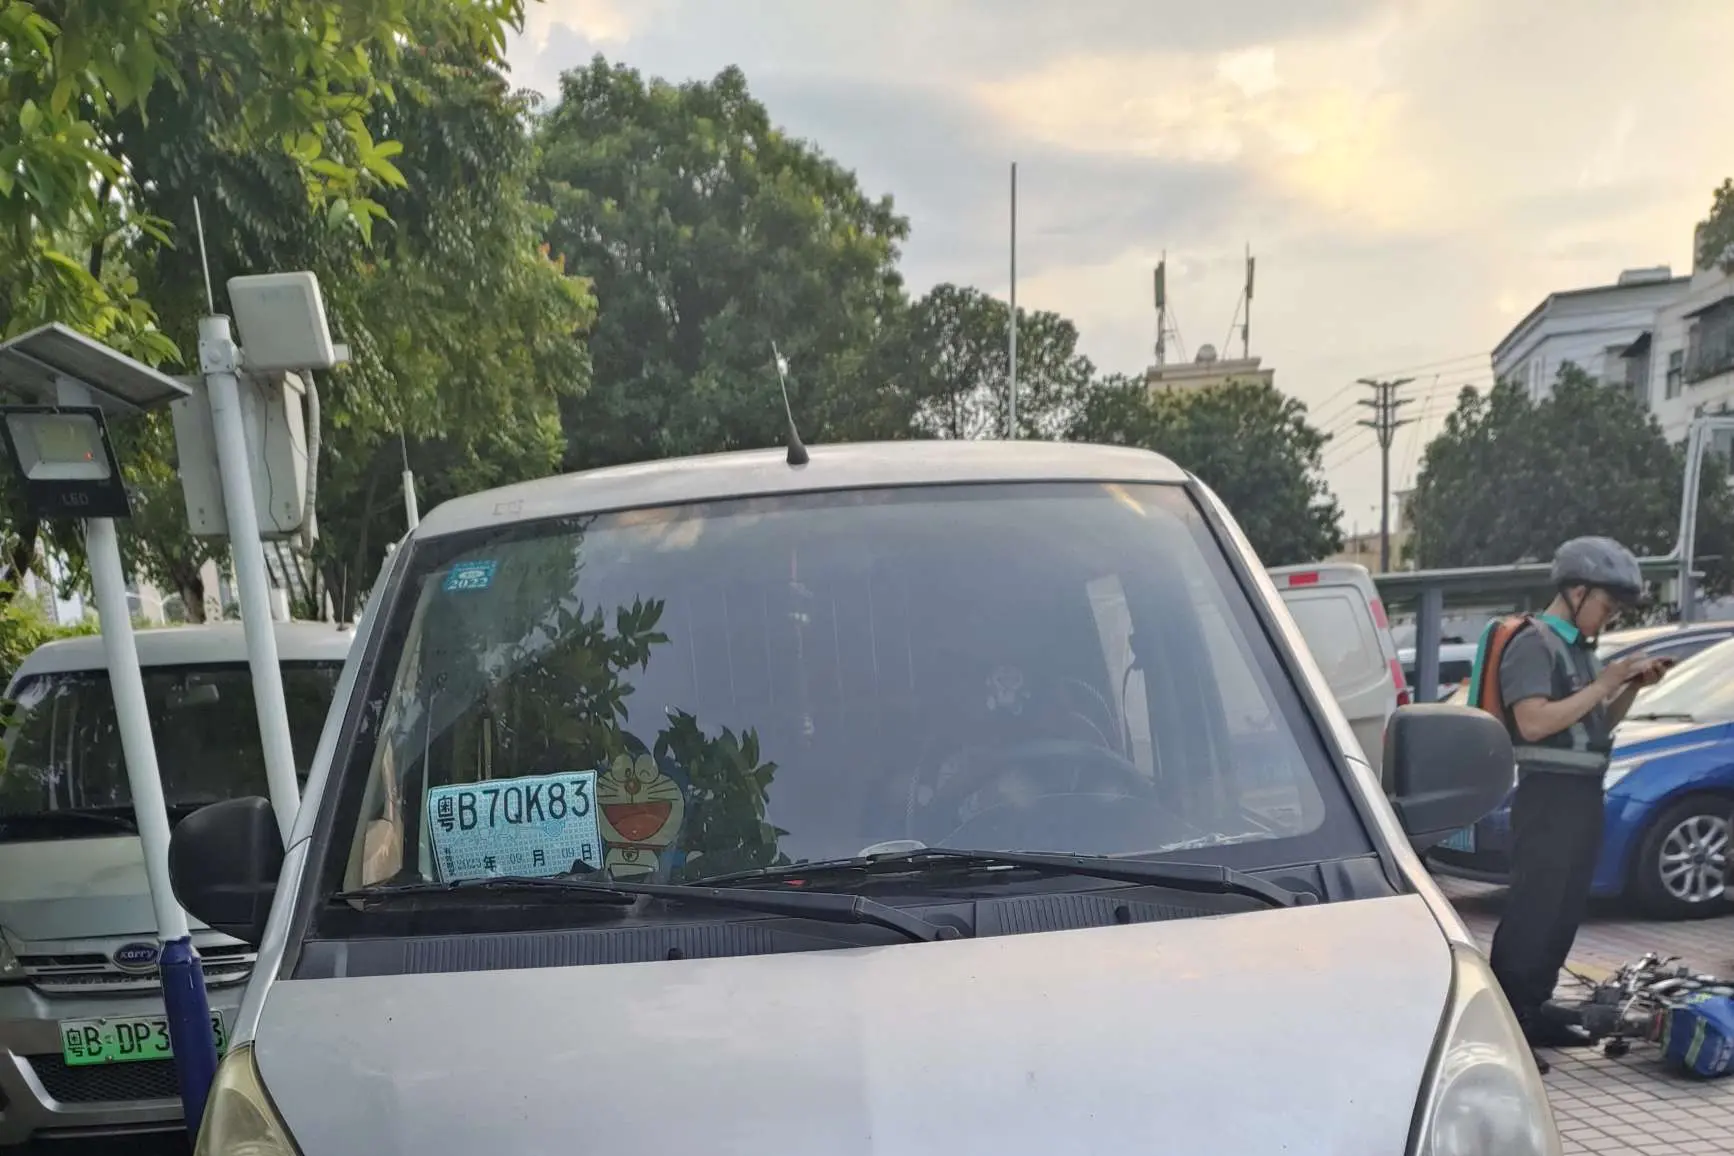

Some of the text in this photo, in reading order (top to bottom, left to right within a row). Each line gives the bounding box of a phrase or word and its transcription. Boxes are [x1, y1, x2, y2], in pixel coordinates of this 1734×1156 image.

[62, 492, 89, 505] LED
[447, 578, 489, 590] 2022
[437, 780, 590, 832] 粤B7QK83
